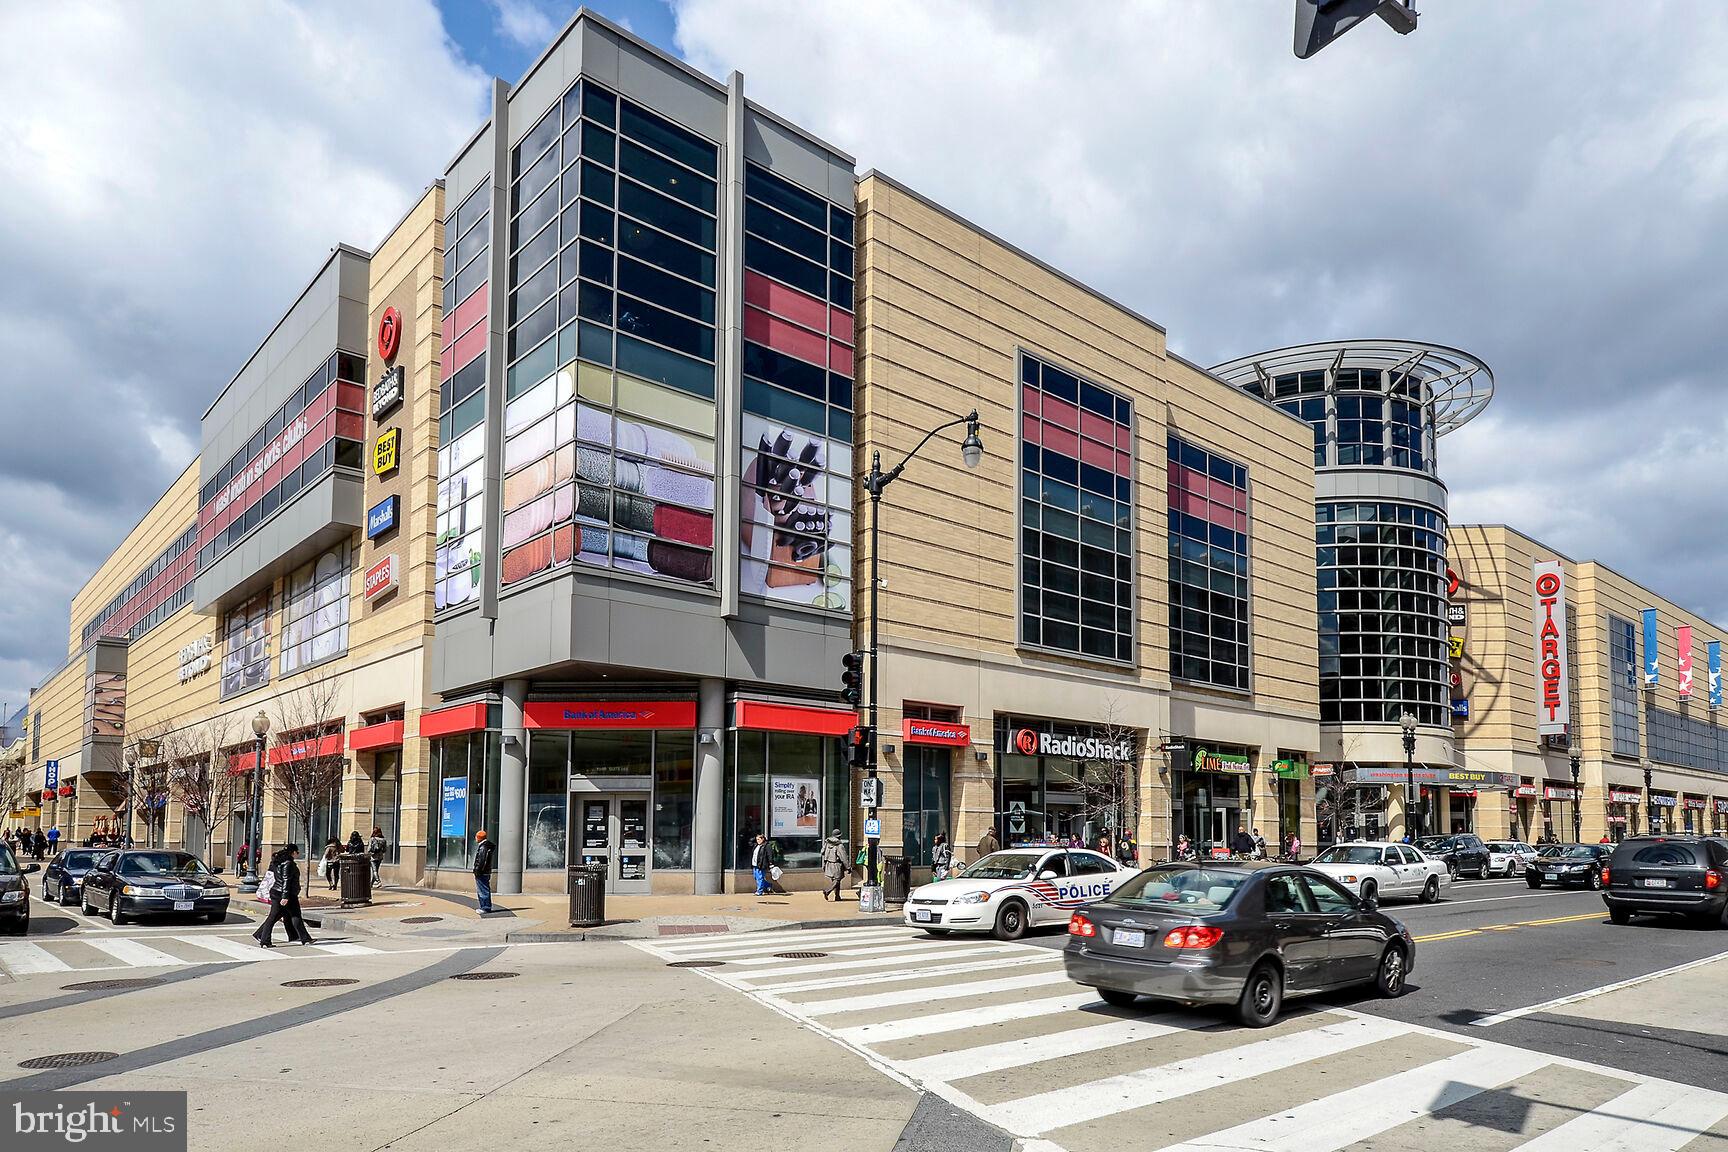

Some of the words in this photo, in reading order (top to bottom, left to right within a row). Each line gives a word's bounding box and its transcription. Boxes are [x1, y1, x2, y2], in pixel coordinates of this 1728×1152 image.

[377, 436, 395, 455] BEST
[377, 451, 393, 468] BUY
[368, 505, 393, 531] Marshalls
[366, 564, 390, 591] STAPLES
[1540, 598, 1561, 722] TARGET
[564, 710, 586, 719] Bank
[599, 710, 637, 719] America
[911, 726, 926, 735] Bank
[932, 728, 956, 738] America
[1040, 732, 1129, 760] RadioShack
[1201, 755, 1223, 770] LIME
[47, 761, 57, 786] IHOP
[1060, 884, 1111, 899] POLICE
